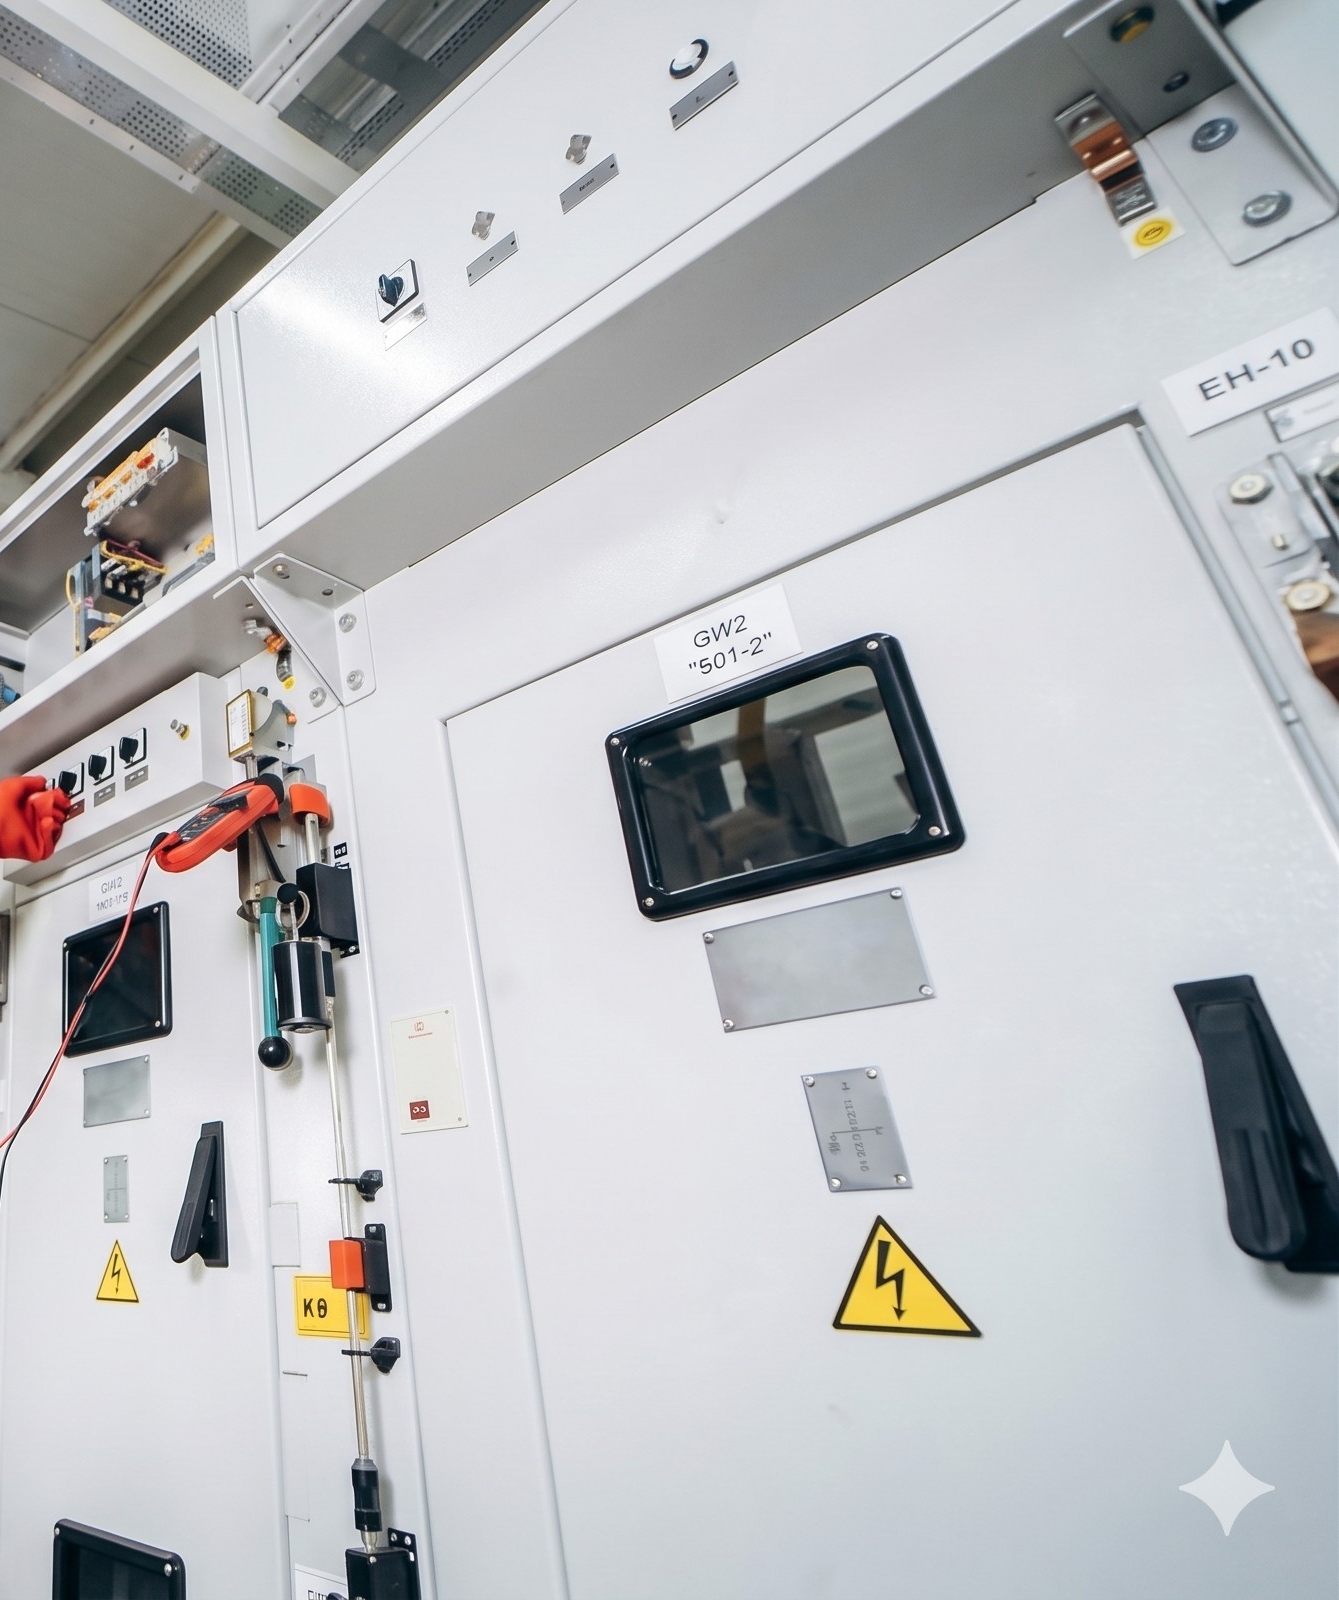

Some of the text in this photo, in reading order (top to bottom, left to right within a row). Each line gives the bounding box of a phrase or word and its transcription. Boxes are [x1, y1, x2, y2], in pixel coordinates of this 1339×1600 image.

[1198, 338, 1314, 401] EH-10
[688, 631, 772, 675] "501-2"
[693, 614, 748, 648] GW2
